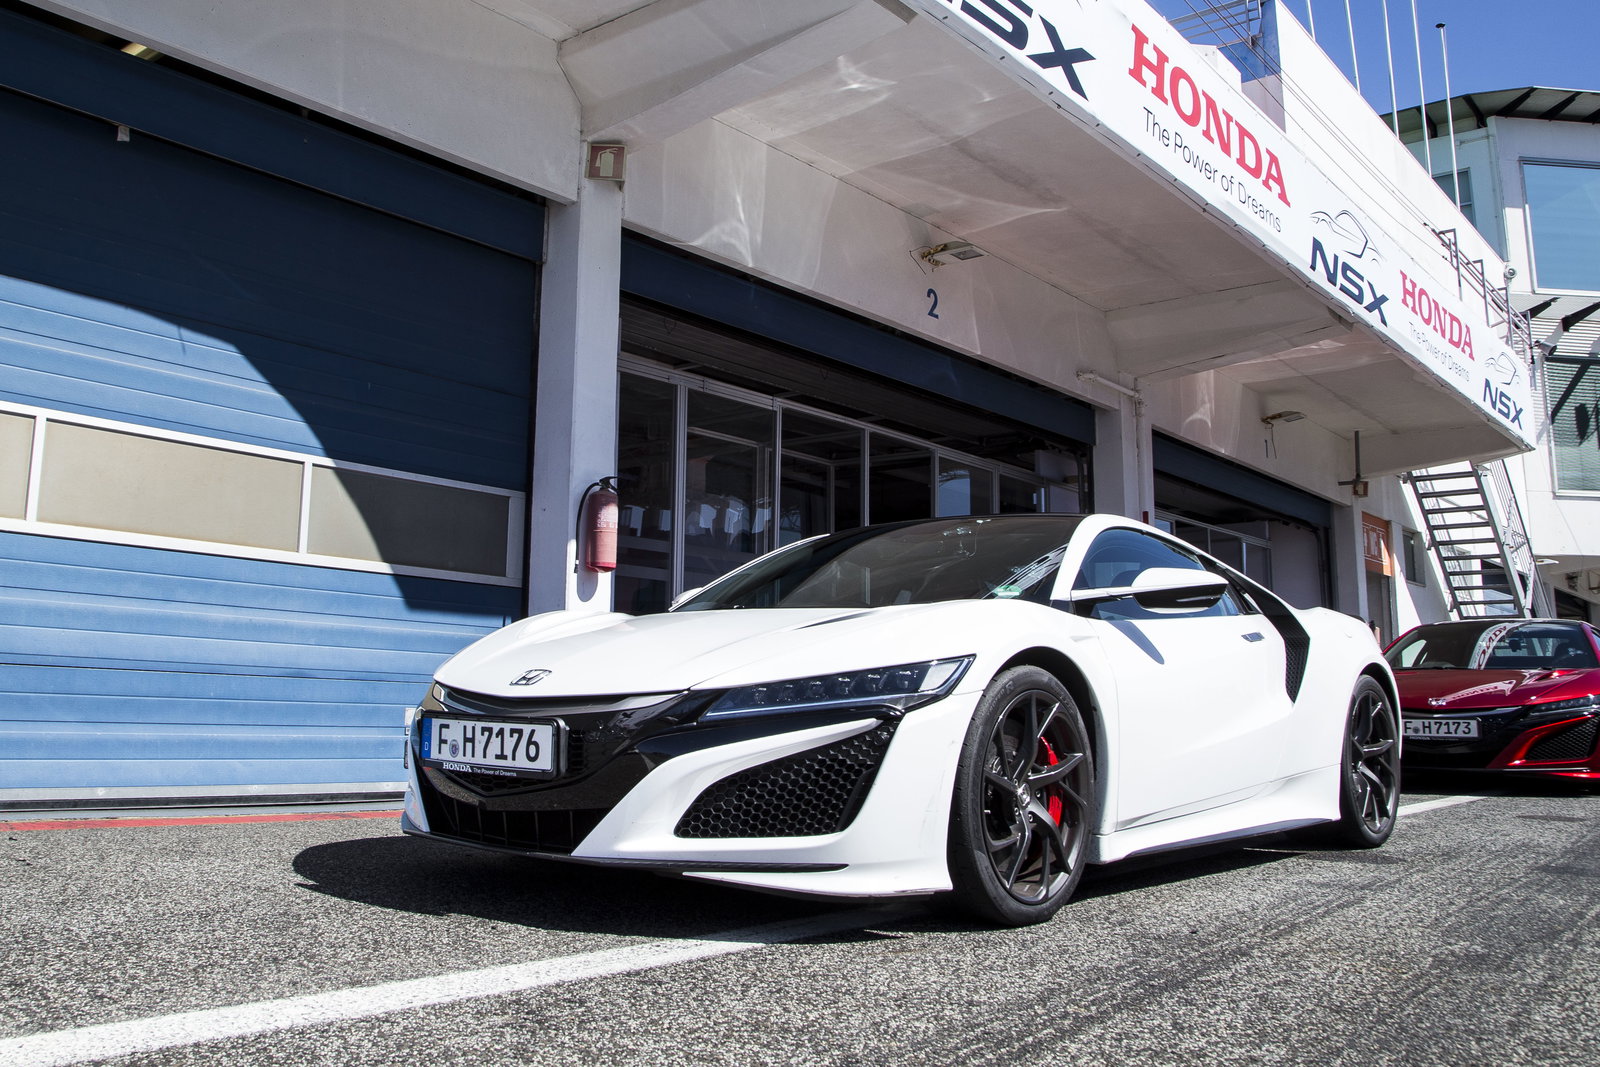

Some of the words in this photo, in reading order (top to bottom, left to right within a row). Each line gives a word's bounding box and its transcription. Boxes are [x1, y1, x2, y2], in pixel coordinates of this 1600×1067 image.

[946, 0, 1097, 102] SX
[1128, 23, 1291, 208] HONDA
[1143, 106, 1170, 147] The
[1174, 131, 1218, 183] Power
[1221, 174, 1235, 196] of
[1238, 181, 1282, 233] Dreams
[926, 288, 939, 320] 2
[1309, 235, 1390, 328] NSX
[1400, 268, 1476, 361] HONDA
[1483, 377, 1524, 431] NSX
[442, 762, 473, 773] HONDA
